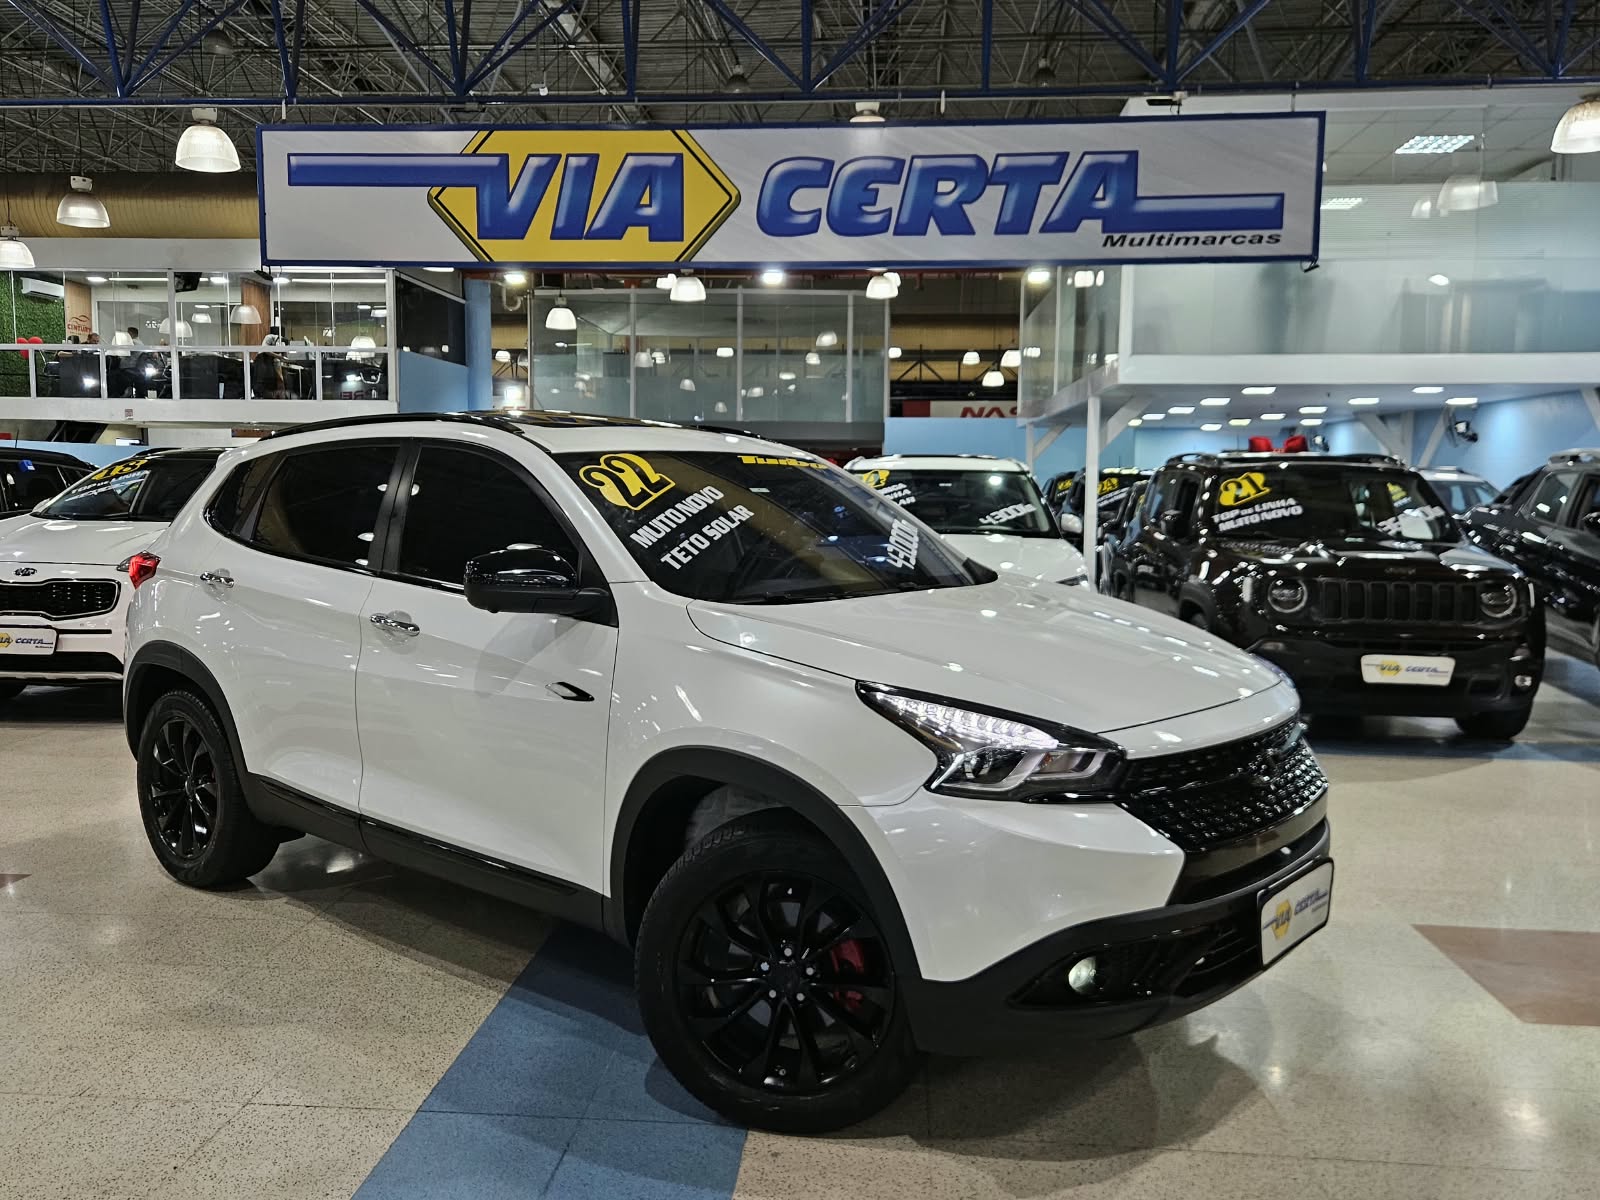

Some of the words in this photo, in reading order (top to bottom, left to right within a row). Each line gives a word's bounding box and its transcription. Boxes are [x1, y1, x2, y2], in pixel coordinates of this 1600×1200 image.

[476, 153, 684, 241] VIA
[756, 150, 1139, 237] CERTA
[1102, 232, 1282, 248] Multimarcas
[737, 455, 828, 470] Turbo
[582, 455, 672, 509] 22
[1222, 473, 1268, 505] 21
[629, 509, 685, 549] MUITO
[674, 485, 725, 520] NOVO
[1211, 508, 1240, 524] TOP
[1255, 497, 1297, 512] LINHA
[1218, 513, 1261, 532] MUITO
[1261, 505, 1304, 521] NOVO
[660, 533, 710, 570] TETO
[702, 504, 755, 541] SOLAR
[1379, 664, 1400, 672] VIA
